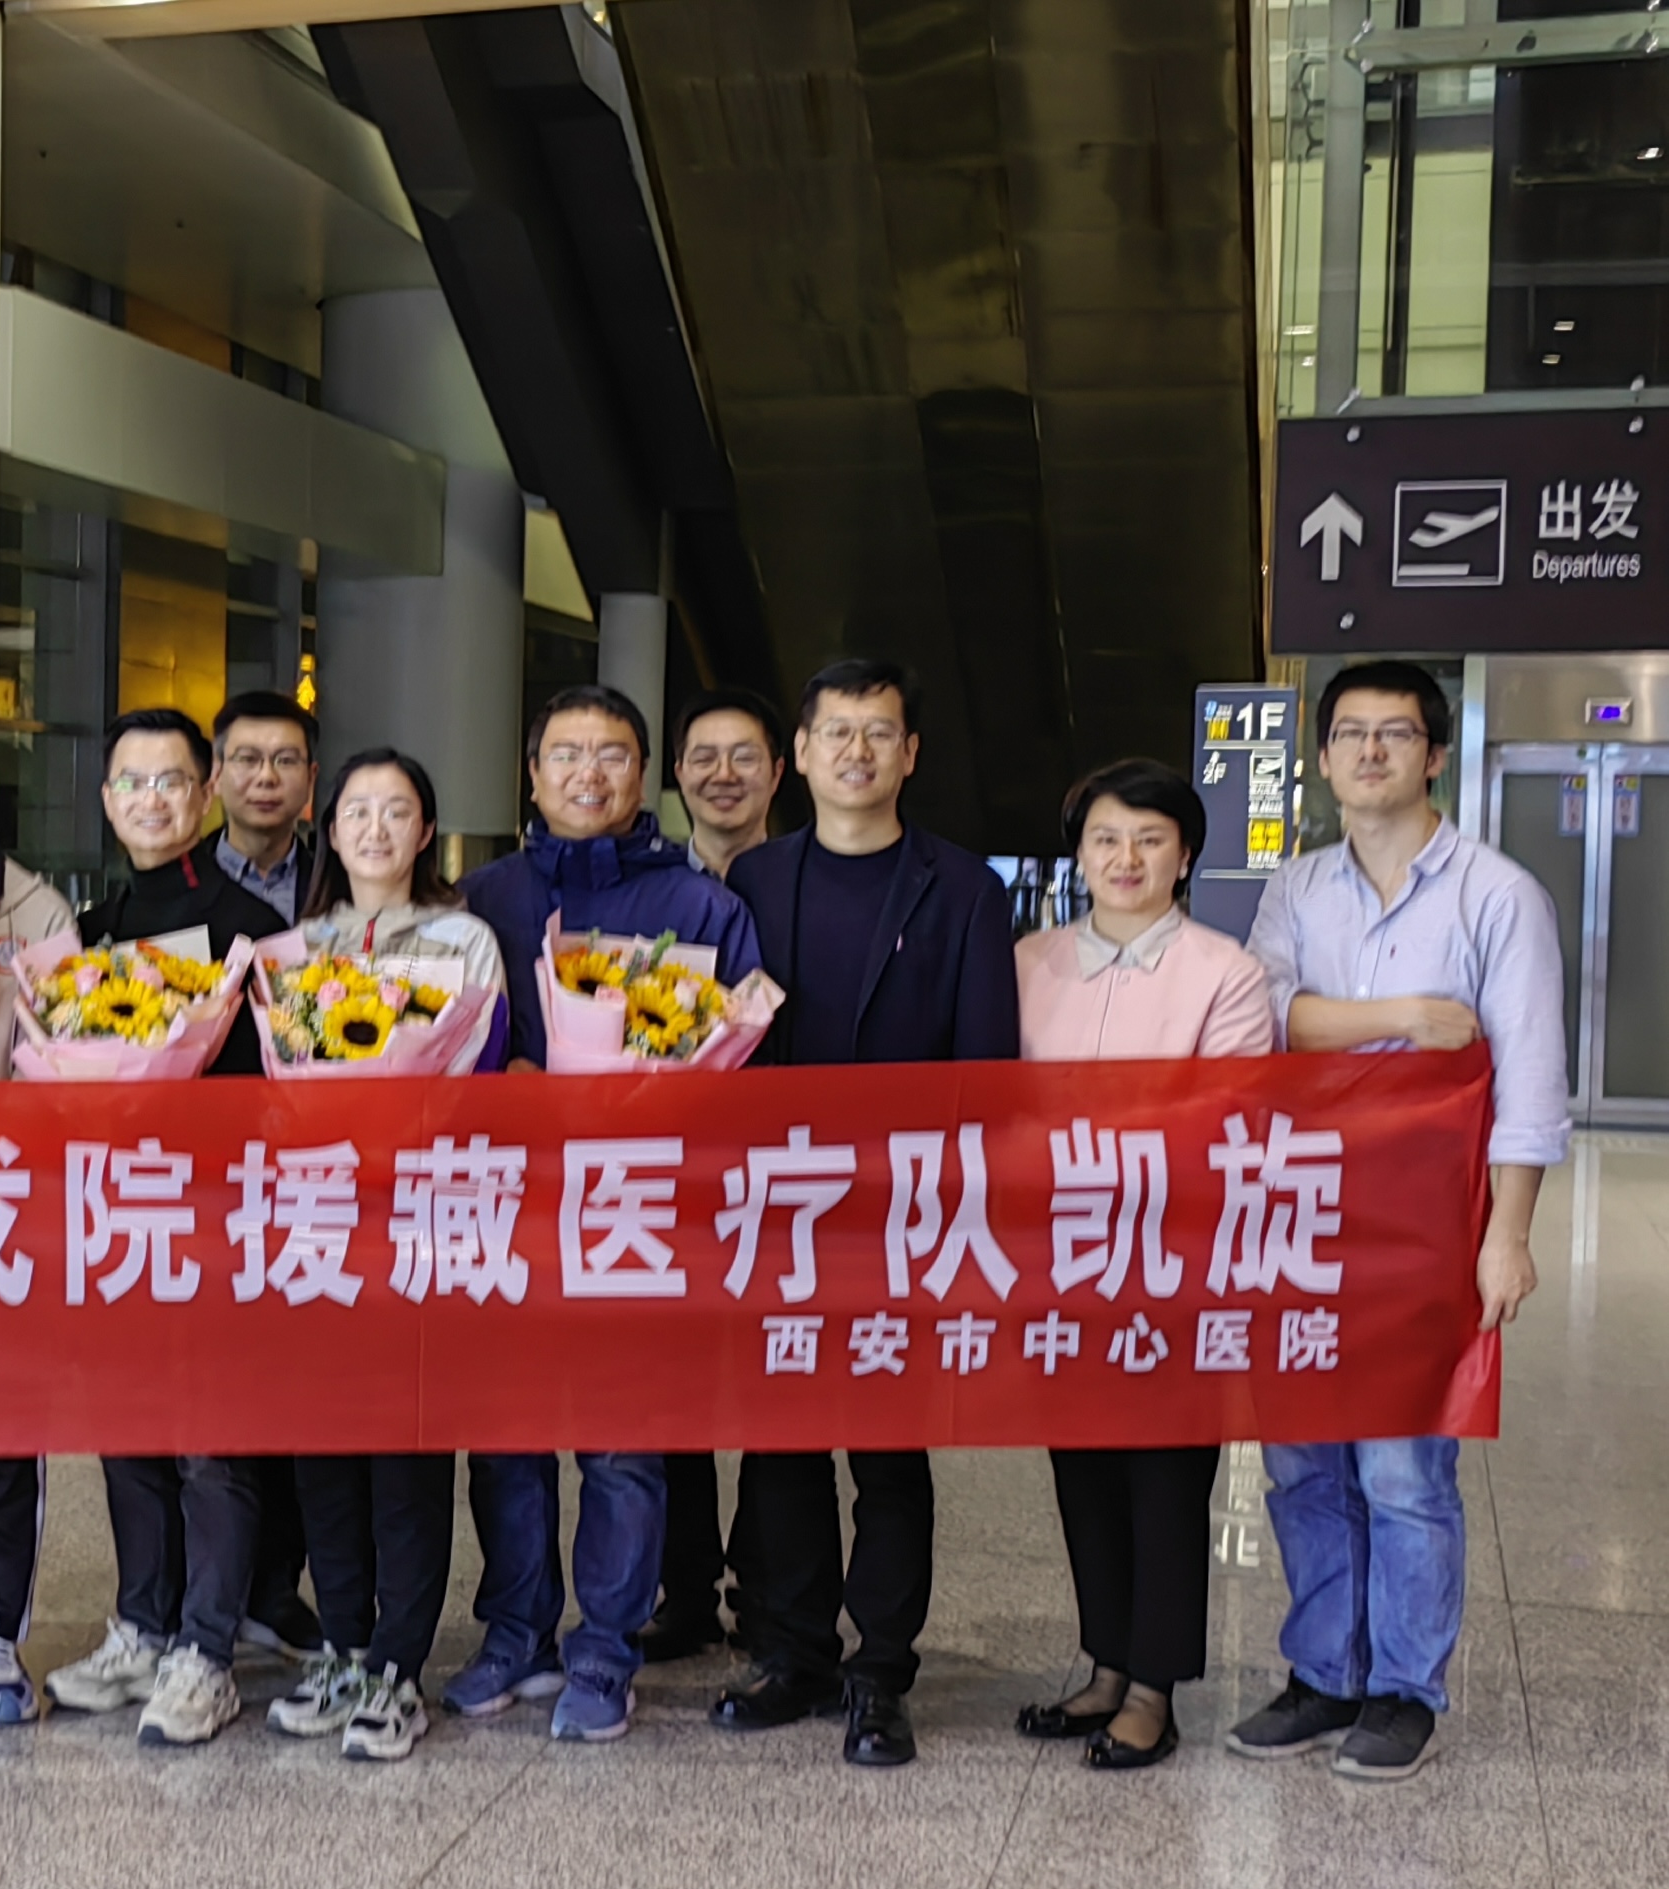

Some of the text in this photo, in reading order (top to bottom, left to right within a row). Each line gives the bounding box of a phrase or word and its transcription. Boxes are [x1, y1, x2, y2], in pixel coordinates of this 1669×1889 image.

[1538, 478, 1639, 541] 出发
[1533, 549, 1641, 584] Departures
[1236, 701, 1286, 741] 1F
[761, 1307, 1341, 1377] 西安市中心医院
